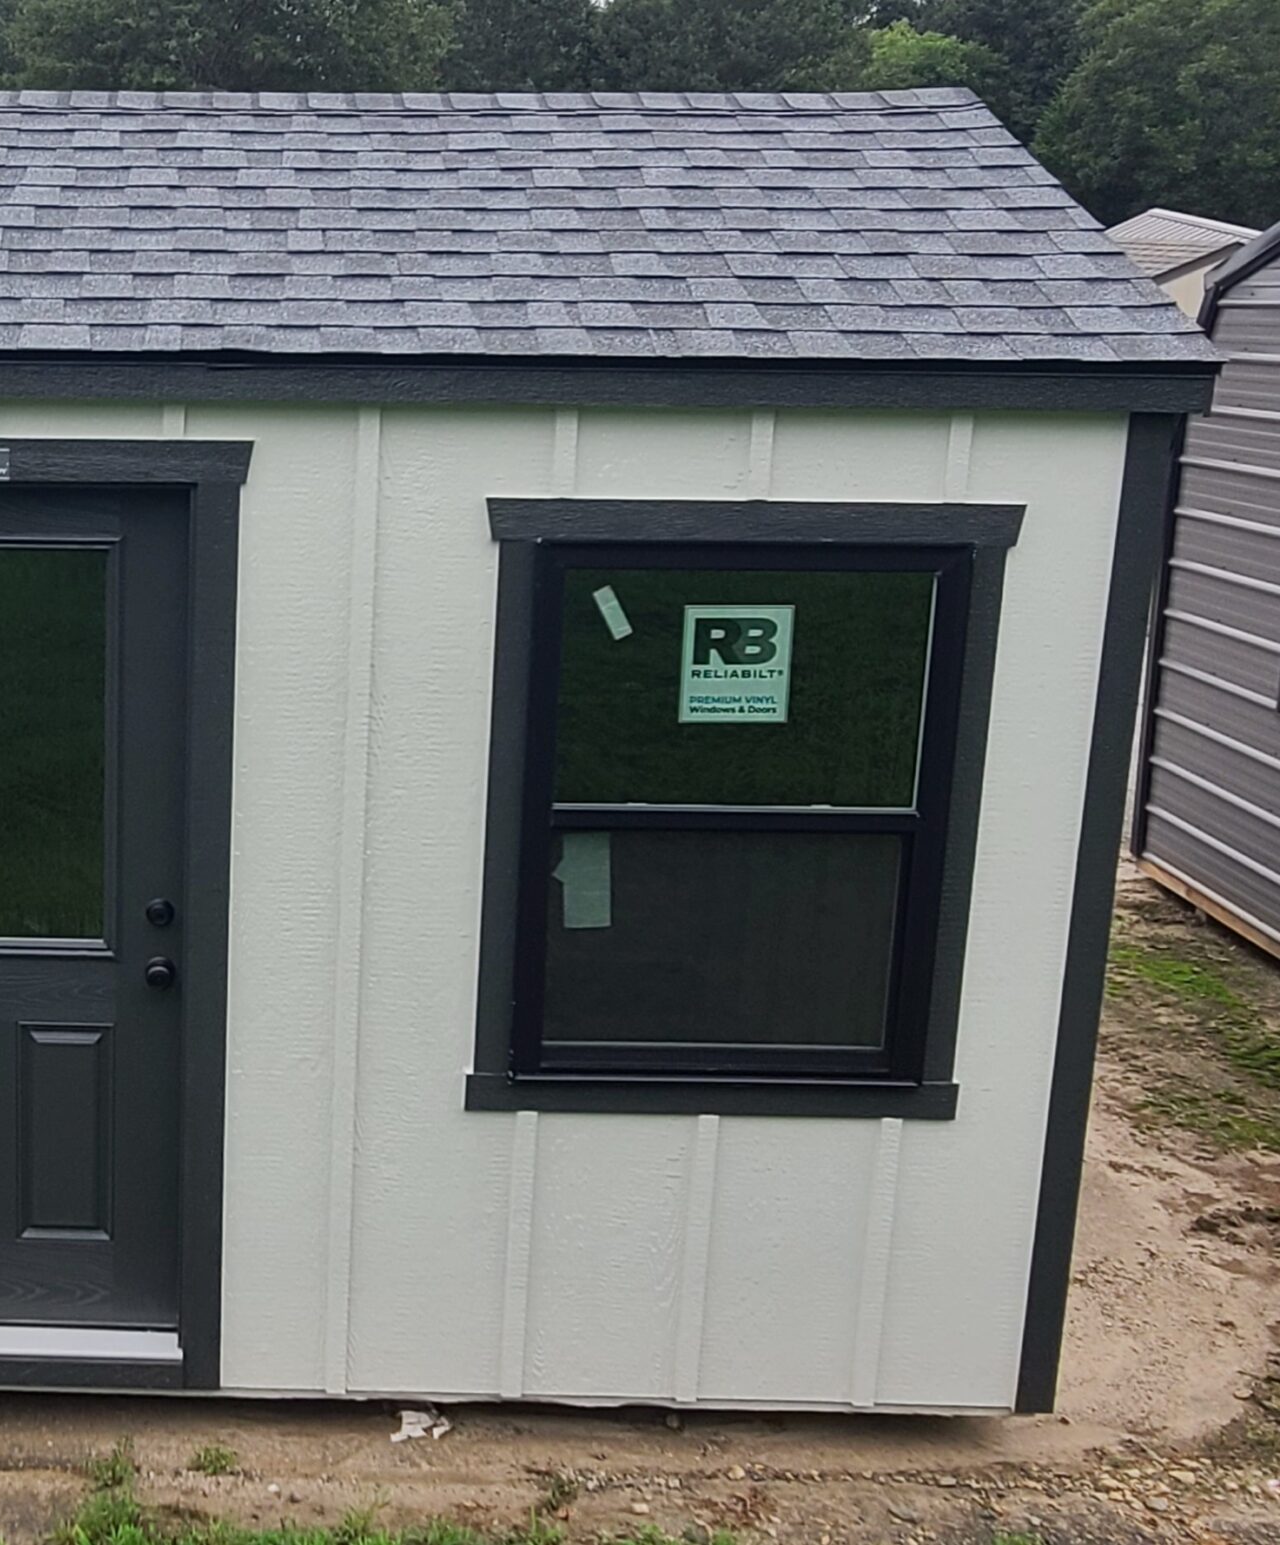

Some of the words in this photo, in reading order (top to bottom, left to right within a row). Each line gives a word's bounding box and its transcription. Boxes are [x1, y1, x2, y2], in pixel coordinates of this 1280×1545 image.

[692, 618, 778, 665] RB
[689, 695, 742, 704] PREMIUM
[744, 695, 777, 704] VINYL
[689, 705, 735, 714] Windows
[737, 705, 746, 714] &
[747, 705, 777, 714] Doors
